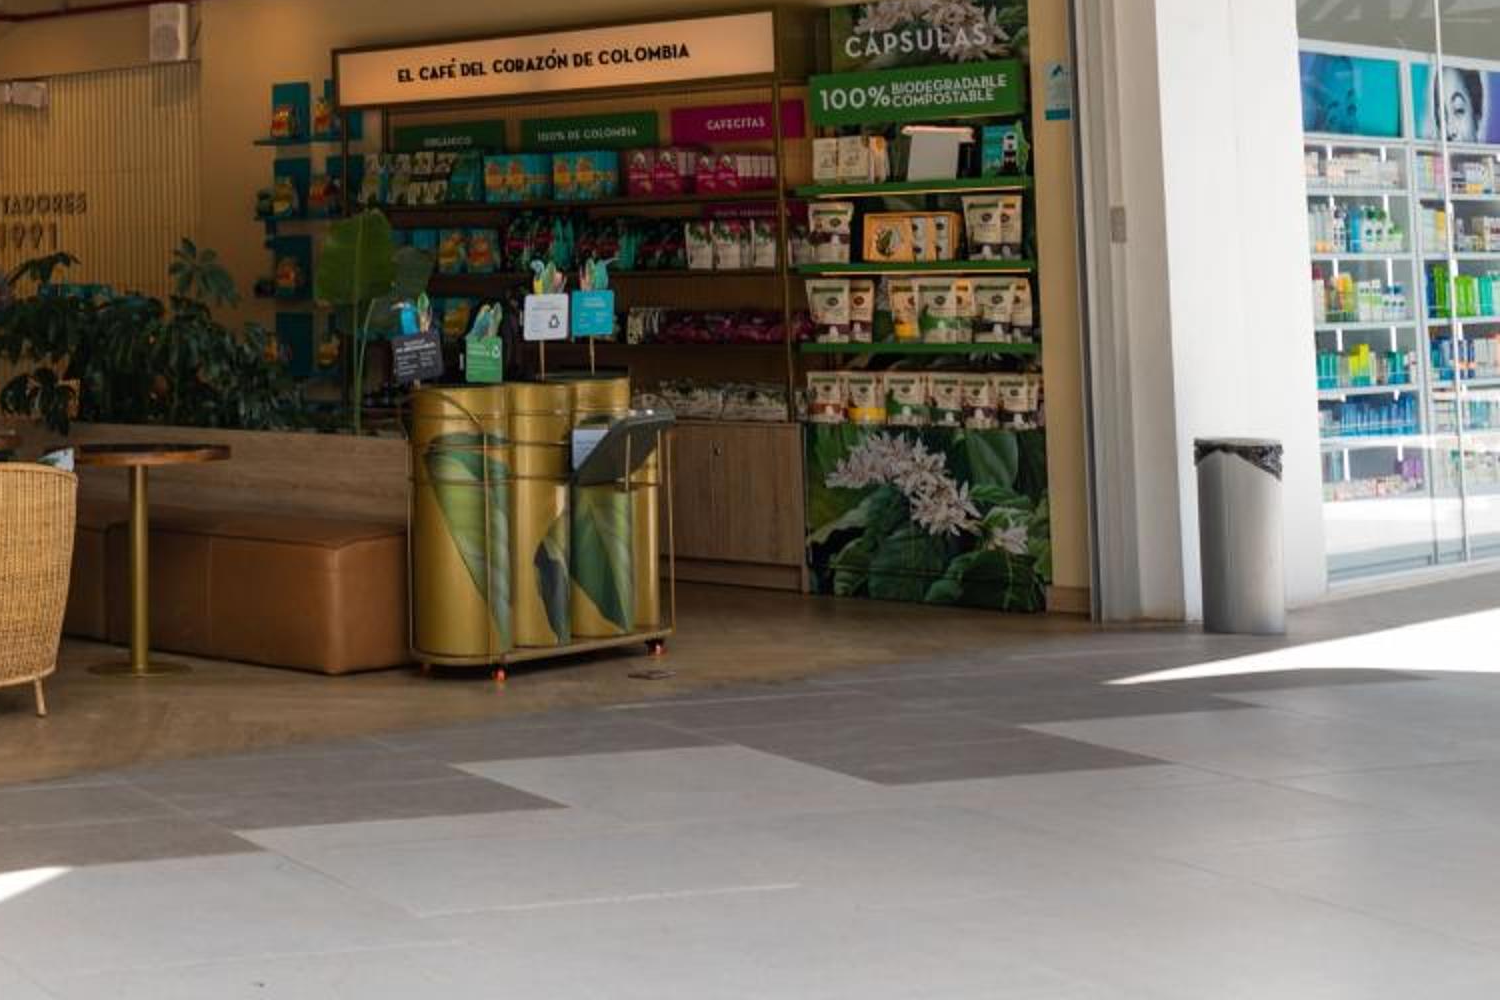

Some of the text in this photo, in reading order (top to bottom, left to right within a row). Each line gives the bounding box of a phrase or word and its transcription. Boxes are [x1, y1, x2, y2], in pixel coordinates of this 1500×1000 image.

[845, 23, 987, 59] CÁPSULAS
[397, 43, 691, 83] EL CAFÉ DEL CORAZÓN DE COLOMBIA
[819, 73, 1008, 112] 100% BIODEGRADABLE
[891, 88, 995, 108] COMPOSTABLE
[584, 127, 637, 139] COLOMBIA
[706, 117, 766, 130] CAFECITAS
